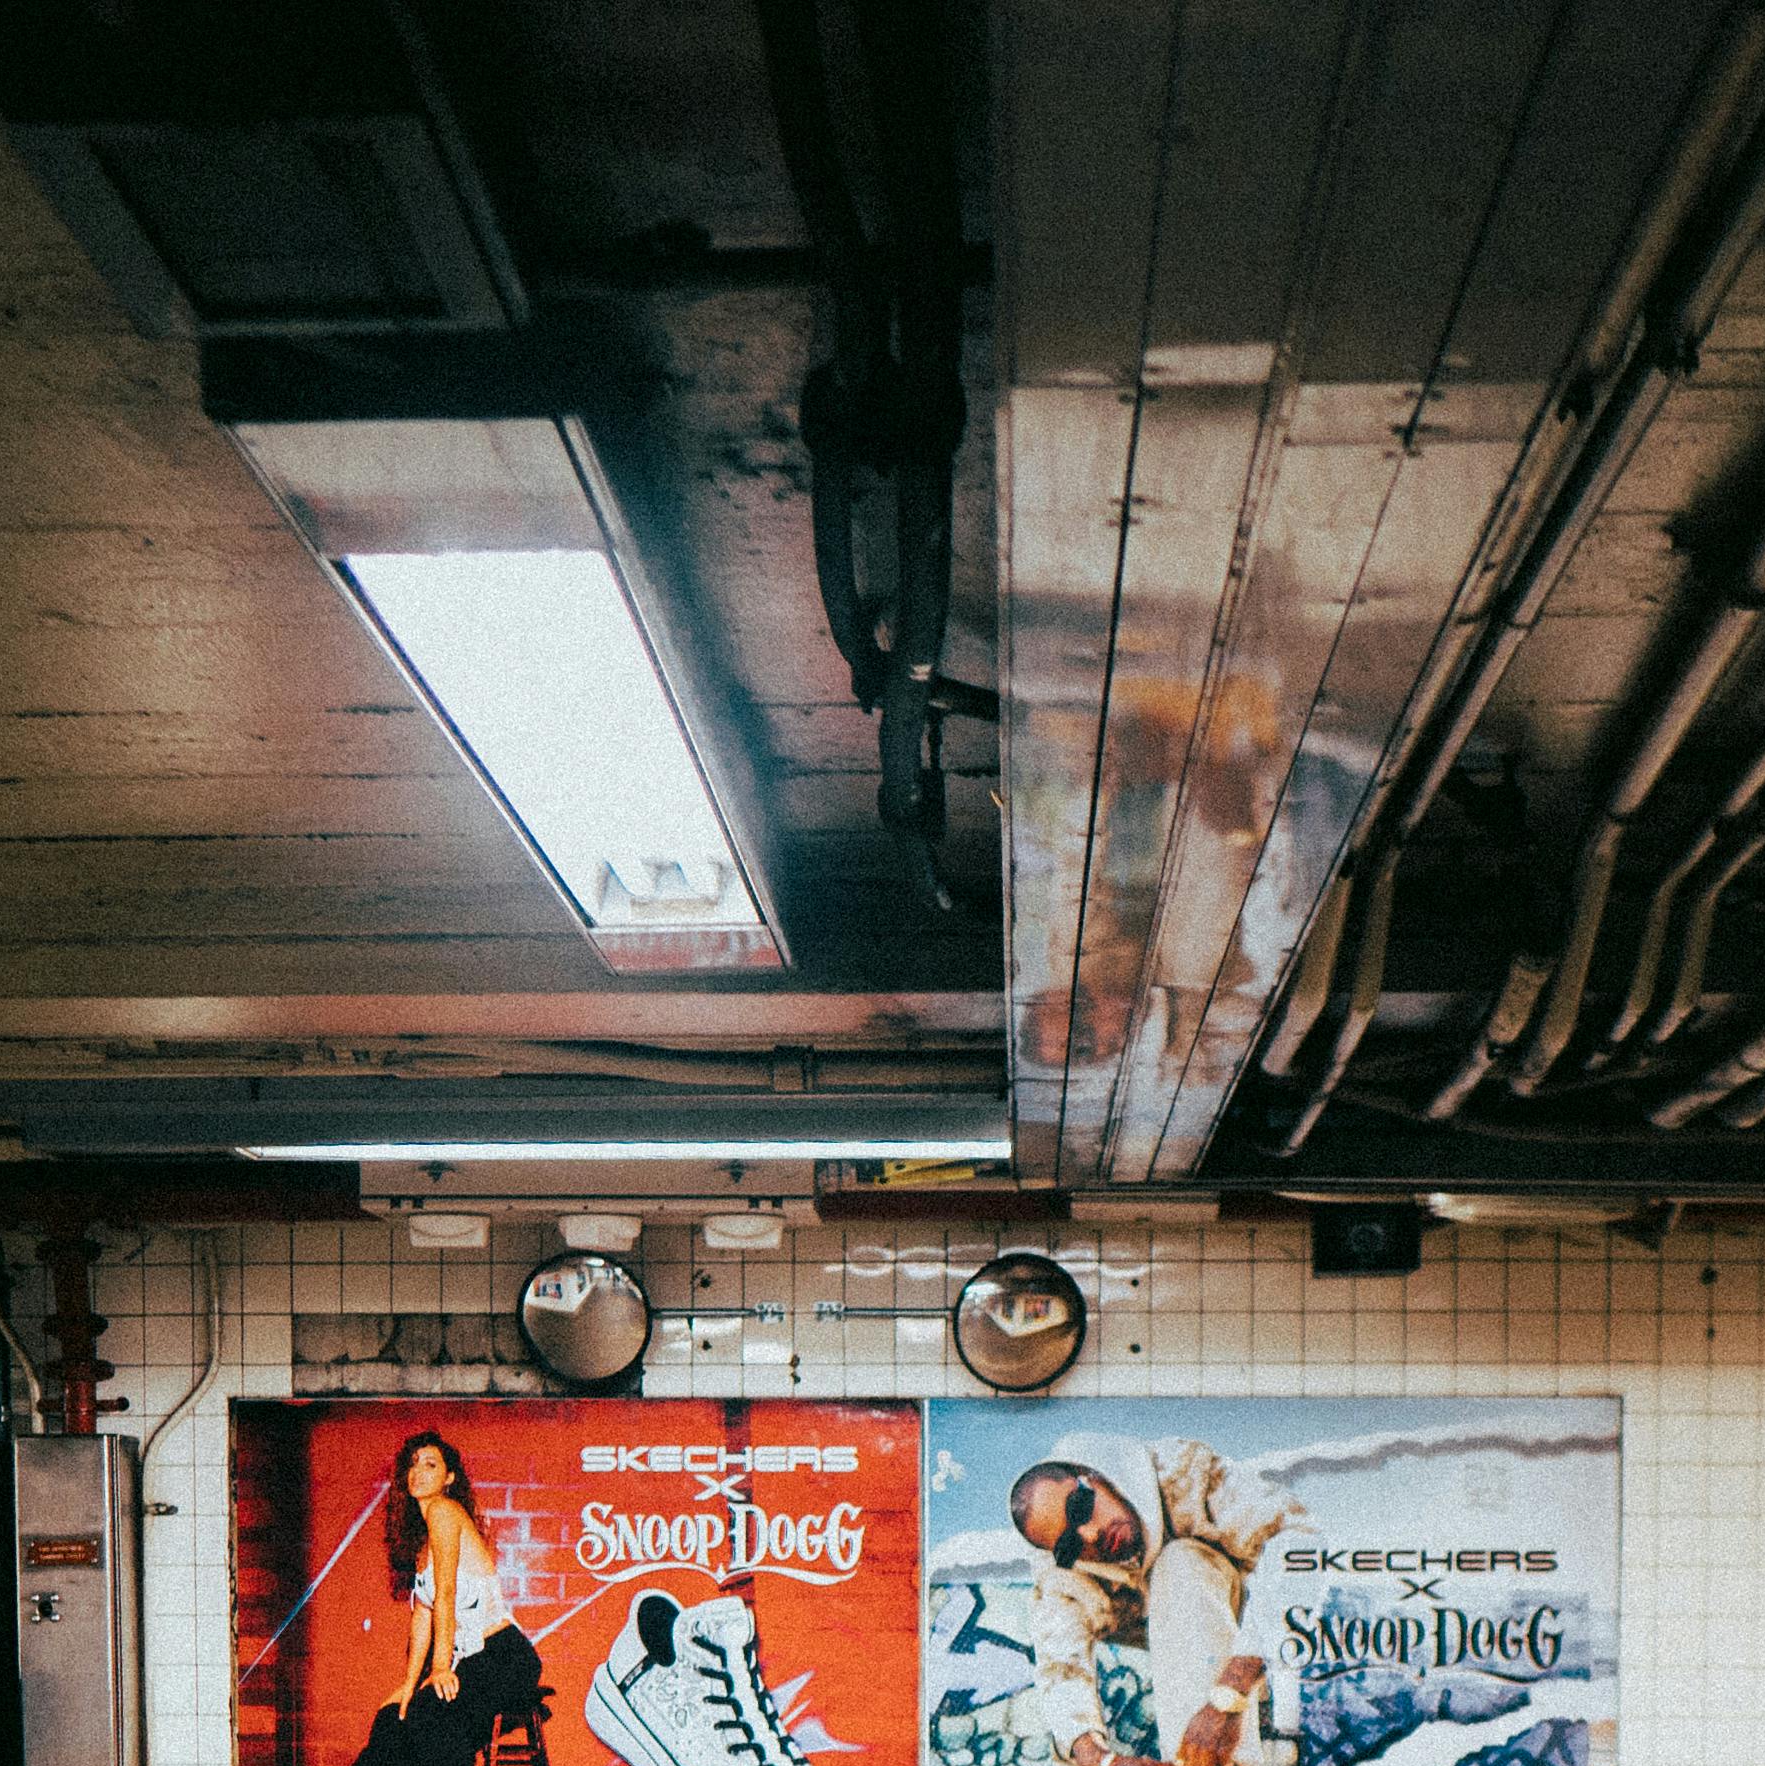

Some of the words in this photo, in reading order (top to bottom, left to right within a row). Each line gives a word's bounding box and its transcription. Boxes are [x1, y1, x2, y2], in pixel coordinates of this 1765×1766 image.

[580, 1444, 859, 1473] SKECHERS
[574, 1501, 726, 1570] SNOOP
[728, 1501, 866, 1571] DOGG
[1284, 1550, 1558, 1573] SKECHERS
[1279, 1604, 1426, 1668] SNOOP
[1431, 1604, 1563, 1669] DOGG
